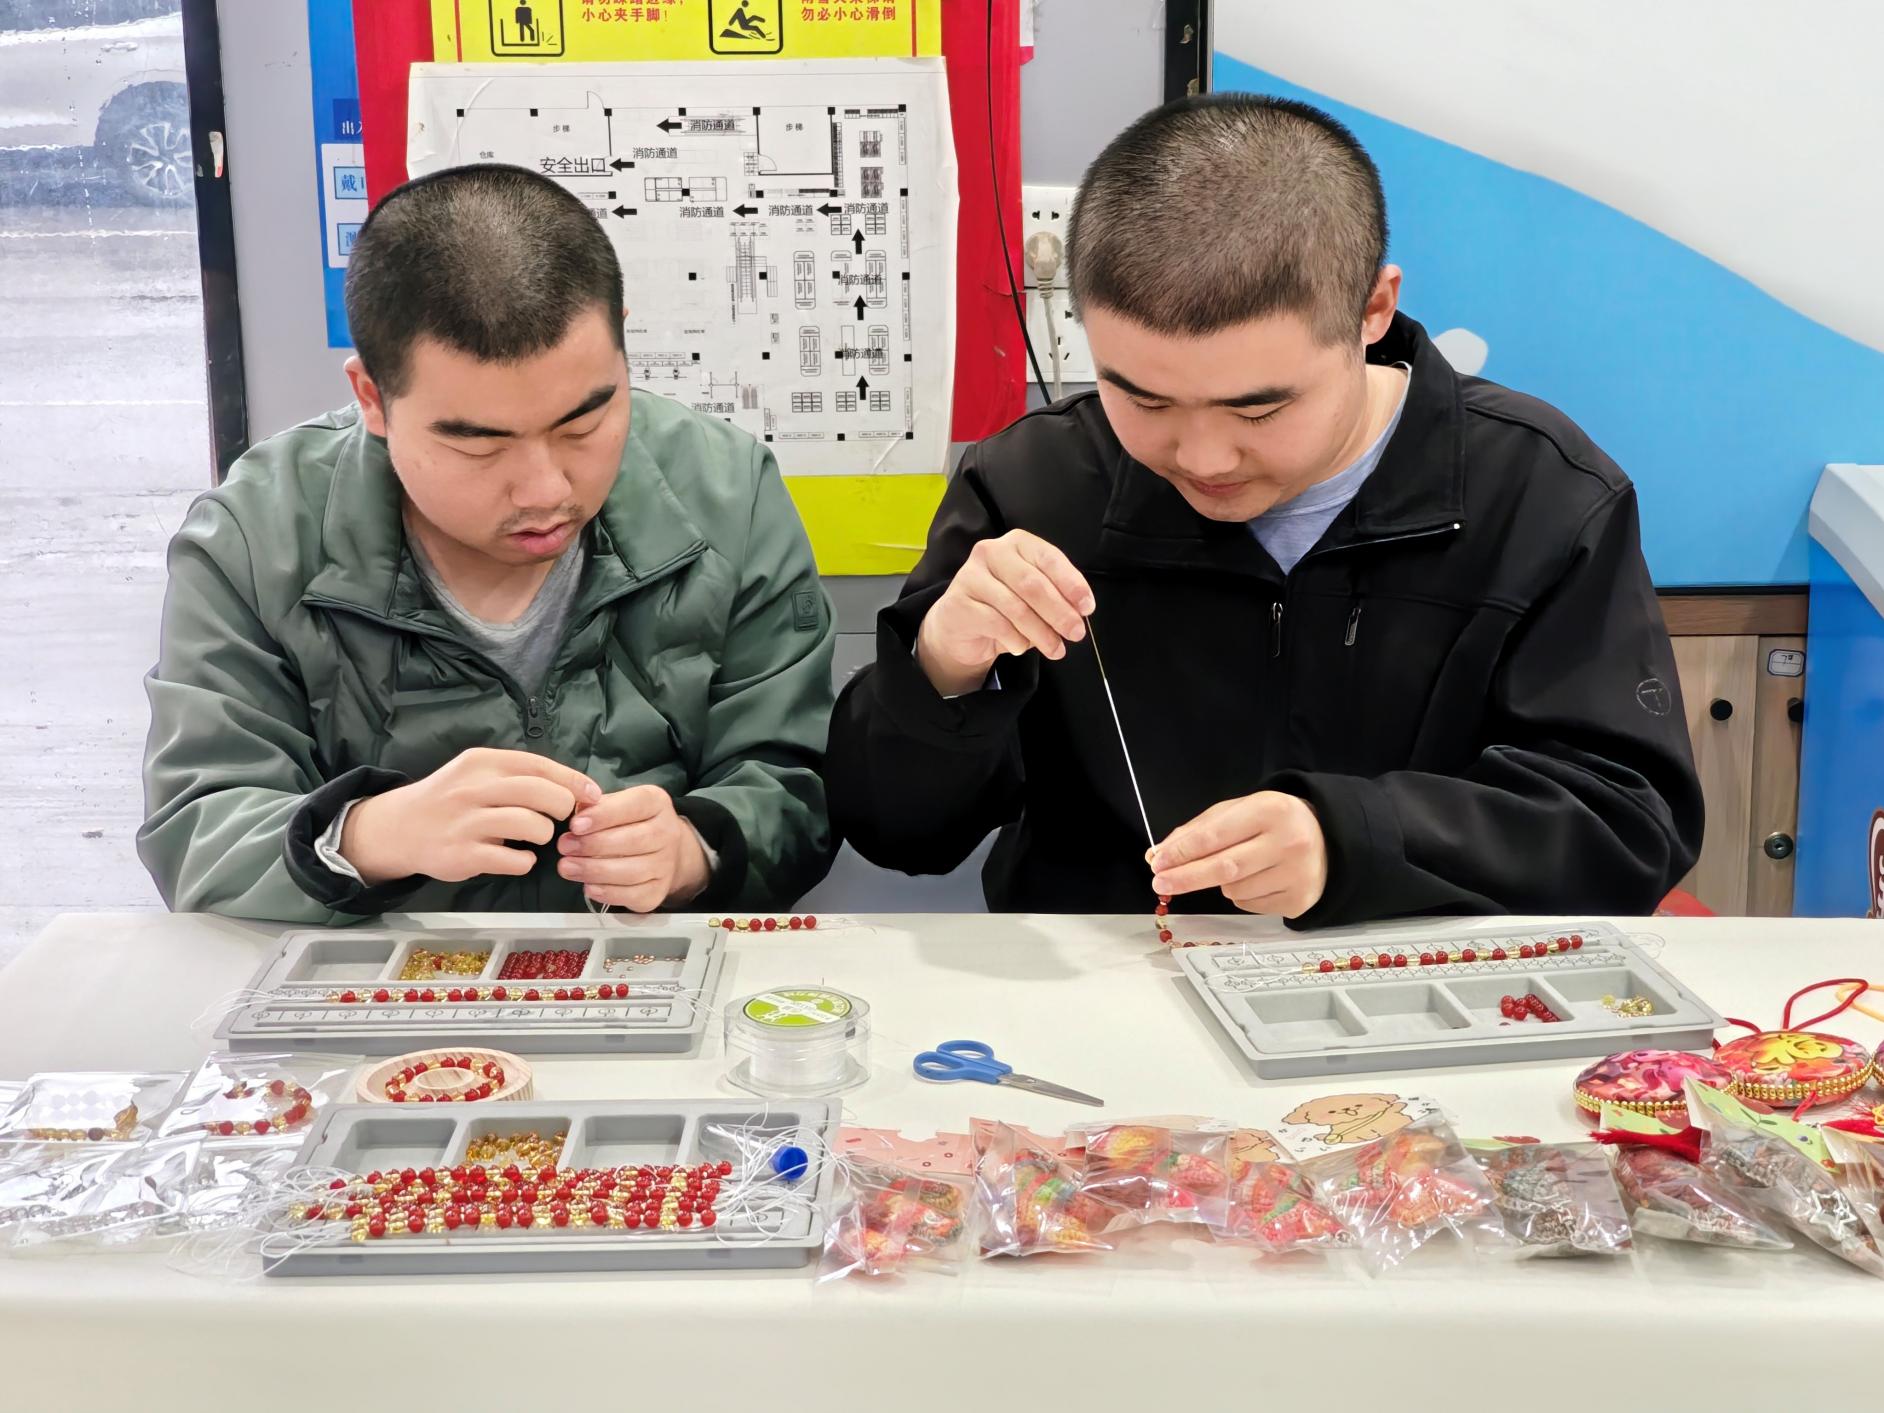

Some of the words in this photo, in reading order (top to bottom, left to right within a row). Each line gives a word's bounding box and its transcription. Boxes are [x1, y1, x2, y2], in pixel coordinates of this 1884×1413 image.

[801, 6, 896, 21] 勿必小心滑倒
[690, 119, 736, 132] 消防通道
[632, 147, 678, 159] 消防通道
[539, 156, 607, 174] 安全出口
[341, 174, 364, 193] 戴
[679, 206, 725, 218] 消防通道
[768, 204, 814, 216] 消防通道
[844, 202, 889, 214] 消防通道
[838, 274, 883, 286] 消防通道
